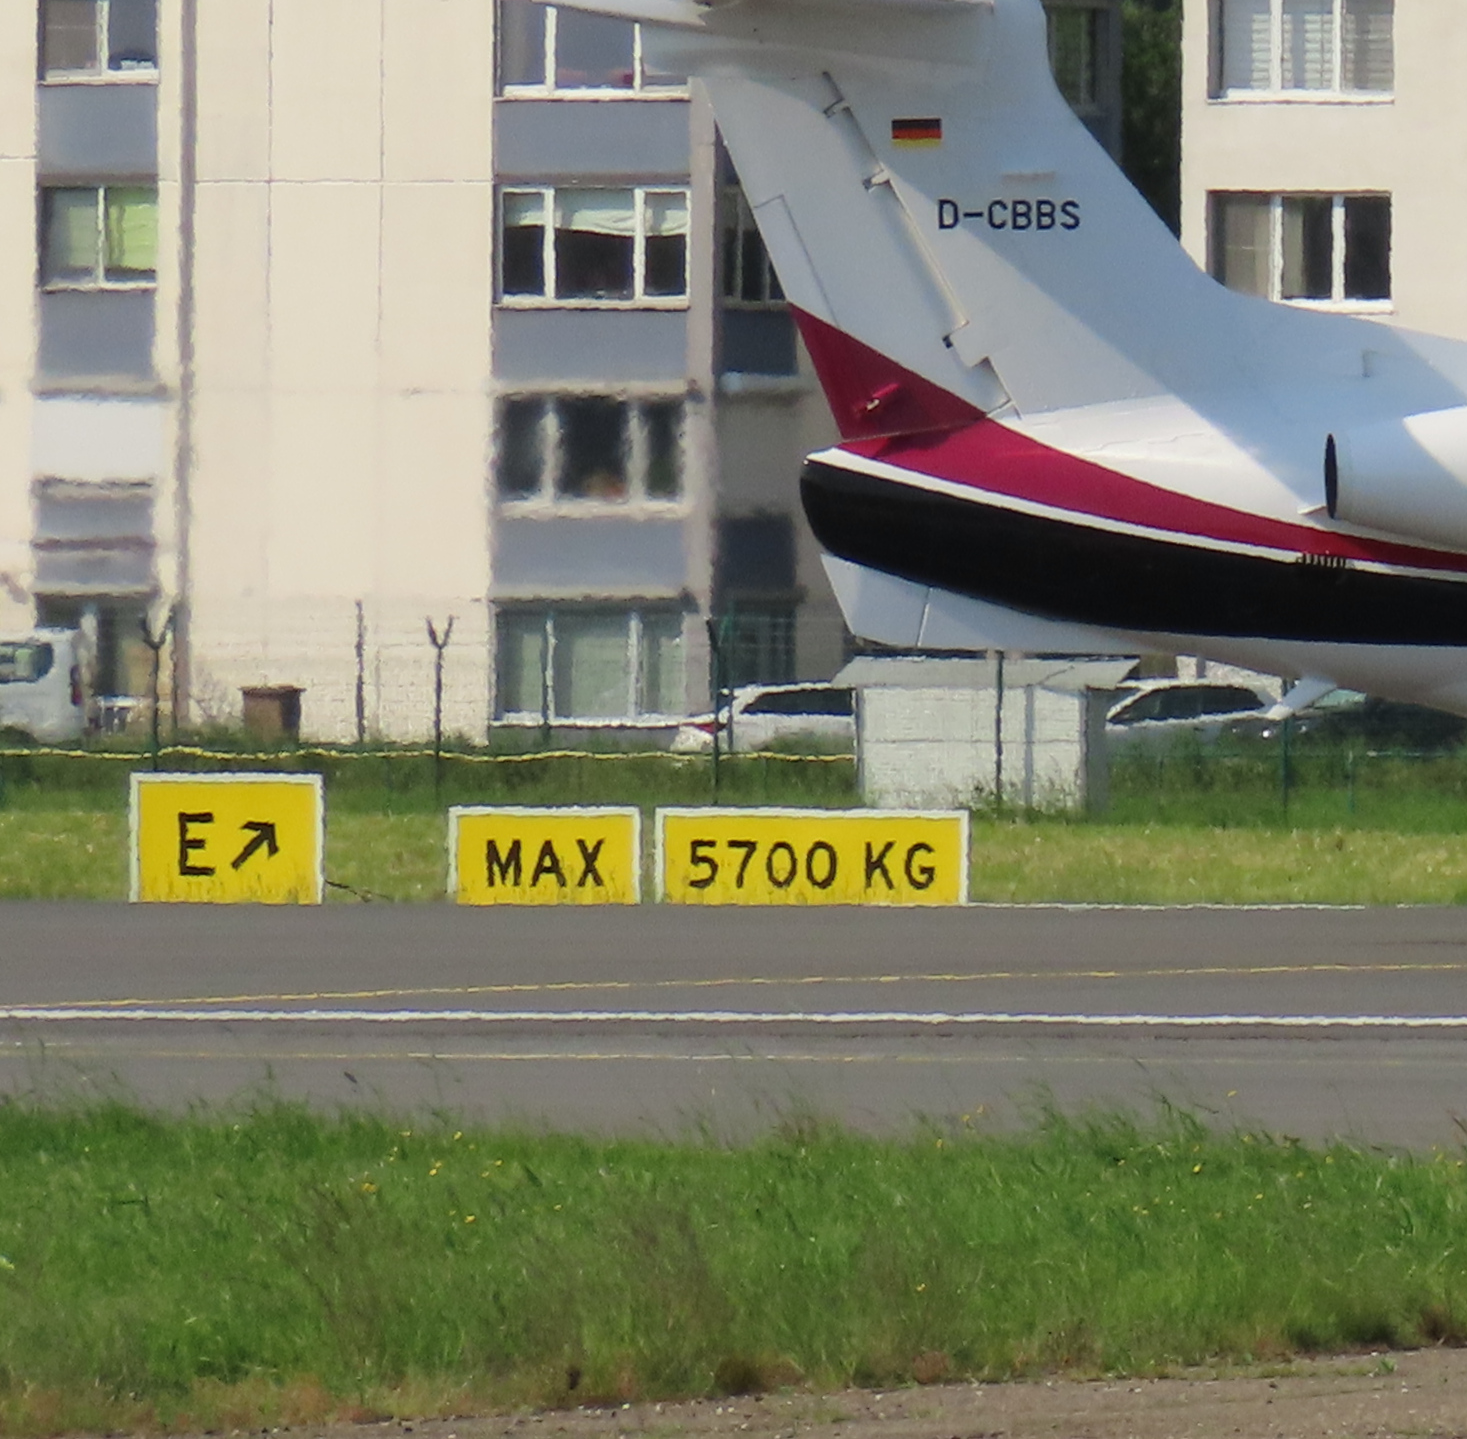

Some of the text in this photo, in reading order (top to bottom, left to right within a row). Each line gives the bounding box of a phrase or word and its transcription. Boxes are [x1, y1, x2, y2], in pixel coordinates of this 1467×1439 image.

[938, 198, 1081, 231] D-CBBS
[177, 811, 216, 877] E
[485, 838, 604, 888] MAX
[688, 839, 935, 891] 5700 KG
